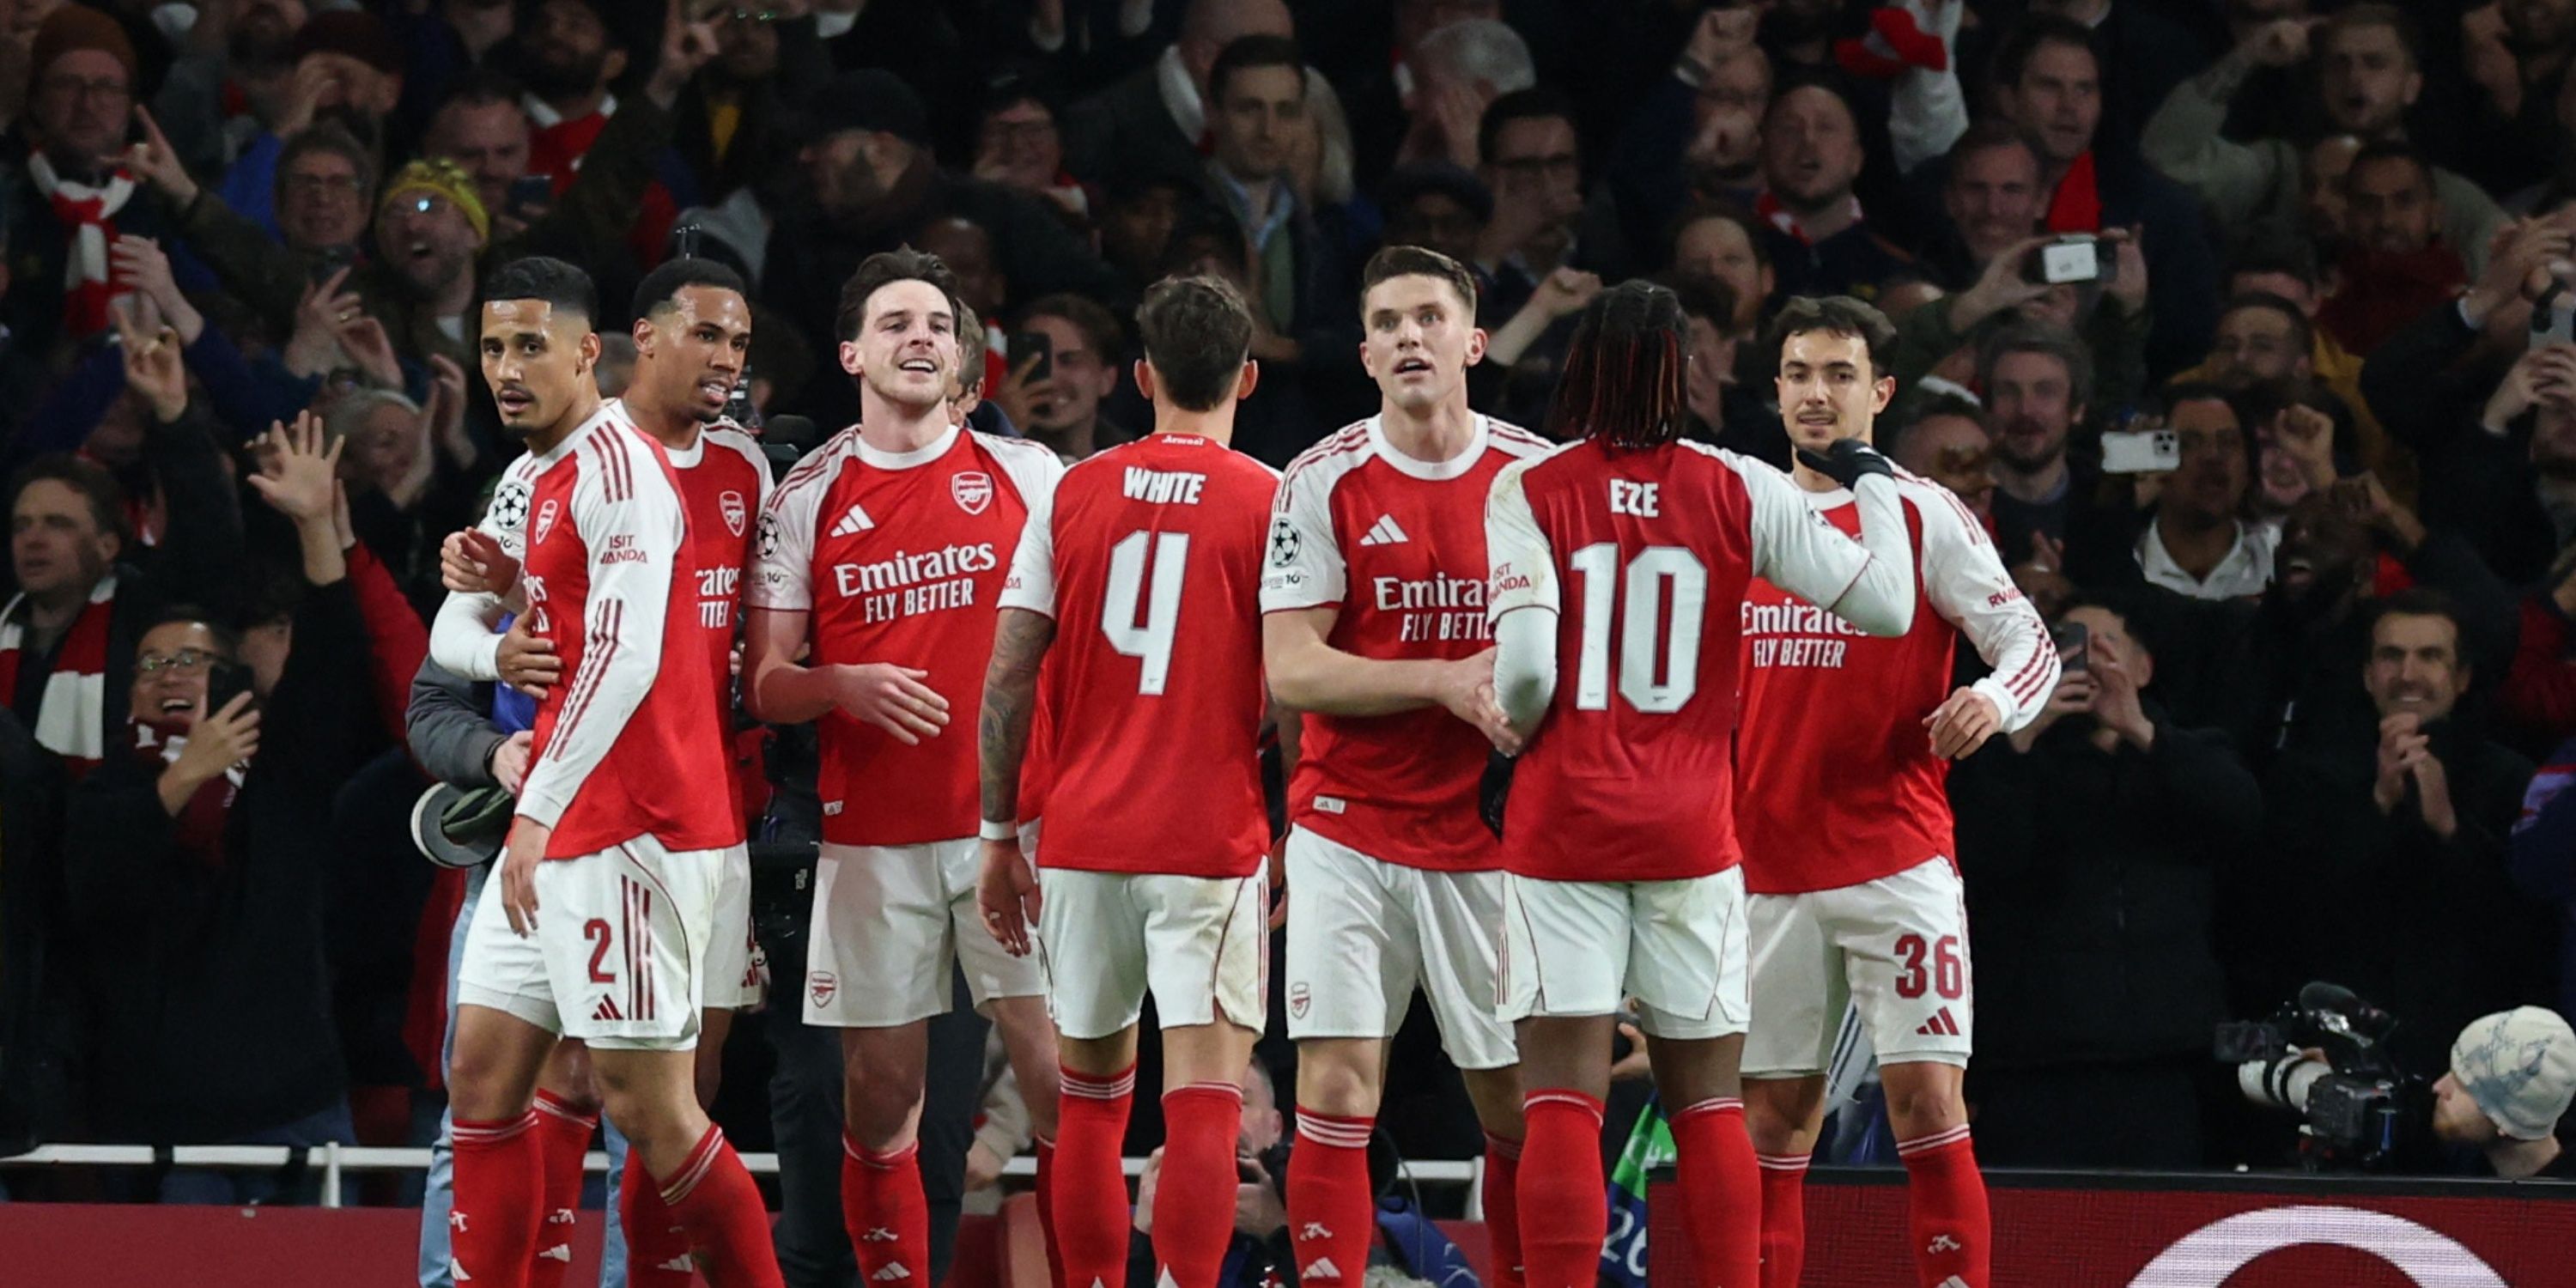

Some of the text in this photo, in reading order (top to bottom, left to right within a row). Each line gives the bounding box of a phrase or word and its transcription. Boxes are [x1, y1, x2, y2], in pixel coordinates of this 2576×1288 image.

[1123, 466, 1206, 505] WHITE
[1610, 478, 1659, 518] EZE
[834, 543, 997, 598] Emirates
[1373, 571, 1490, 611] Emira
[865, 578, 974, 623] FLY BETTER
[1101, 529, 1189, 696] 4
[1400, 612, 1433, 642] FLY
[1571, 542, 1707, 714] 10
[1753, 639, 1846, 668] FLY BETTER
[584, 918, 617, 984] 2
[1894, 933, 1963, 1000] 36
